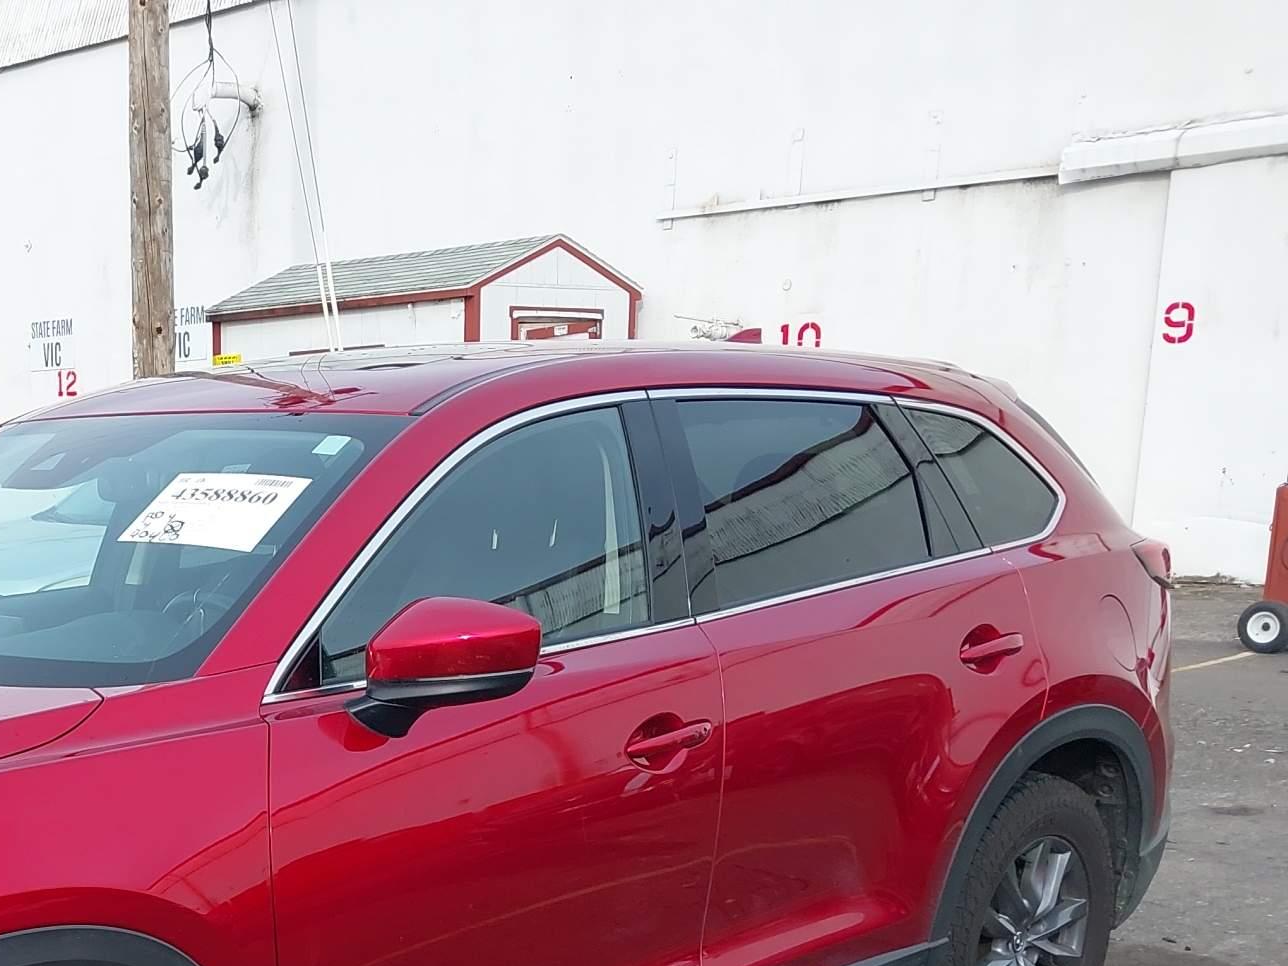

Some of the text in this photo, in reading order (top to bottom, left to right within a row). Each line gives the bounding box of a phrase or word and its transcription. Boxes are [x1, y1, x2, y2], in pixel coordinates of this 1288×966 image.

[180, 305, 205, 326] FARM
[1162, 302, 1195, 343] 9
[31, 318, 73, 339] STATE FARM
[43, 342, 62, 367] VIC
[57, 369, 77, 397] 12
[171, 488, 278, 505] 43588860
